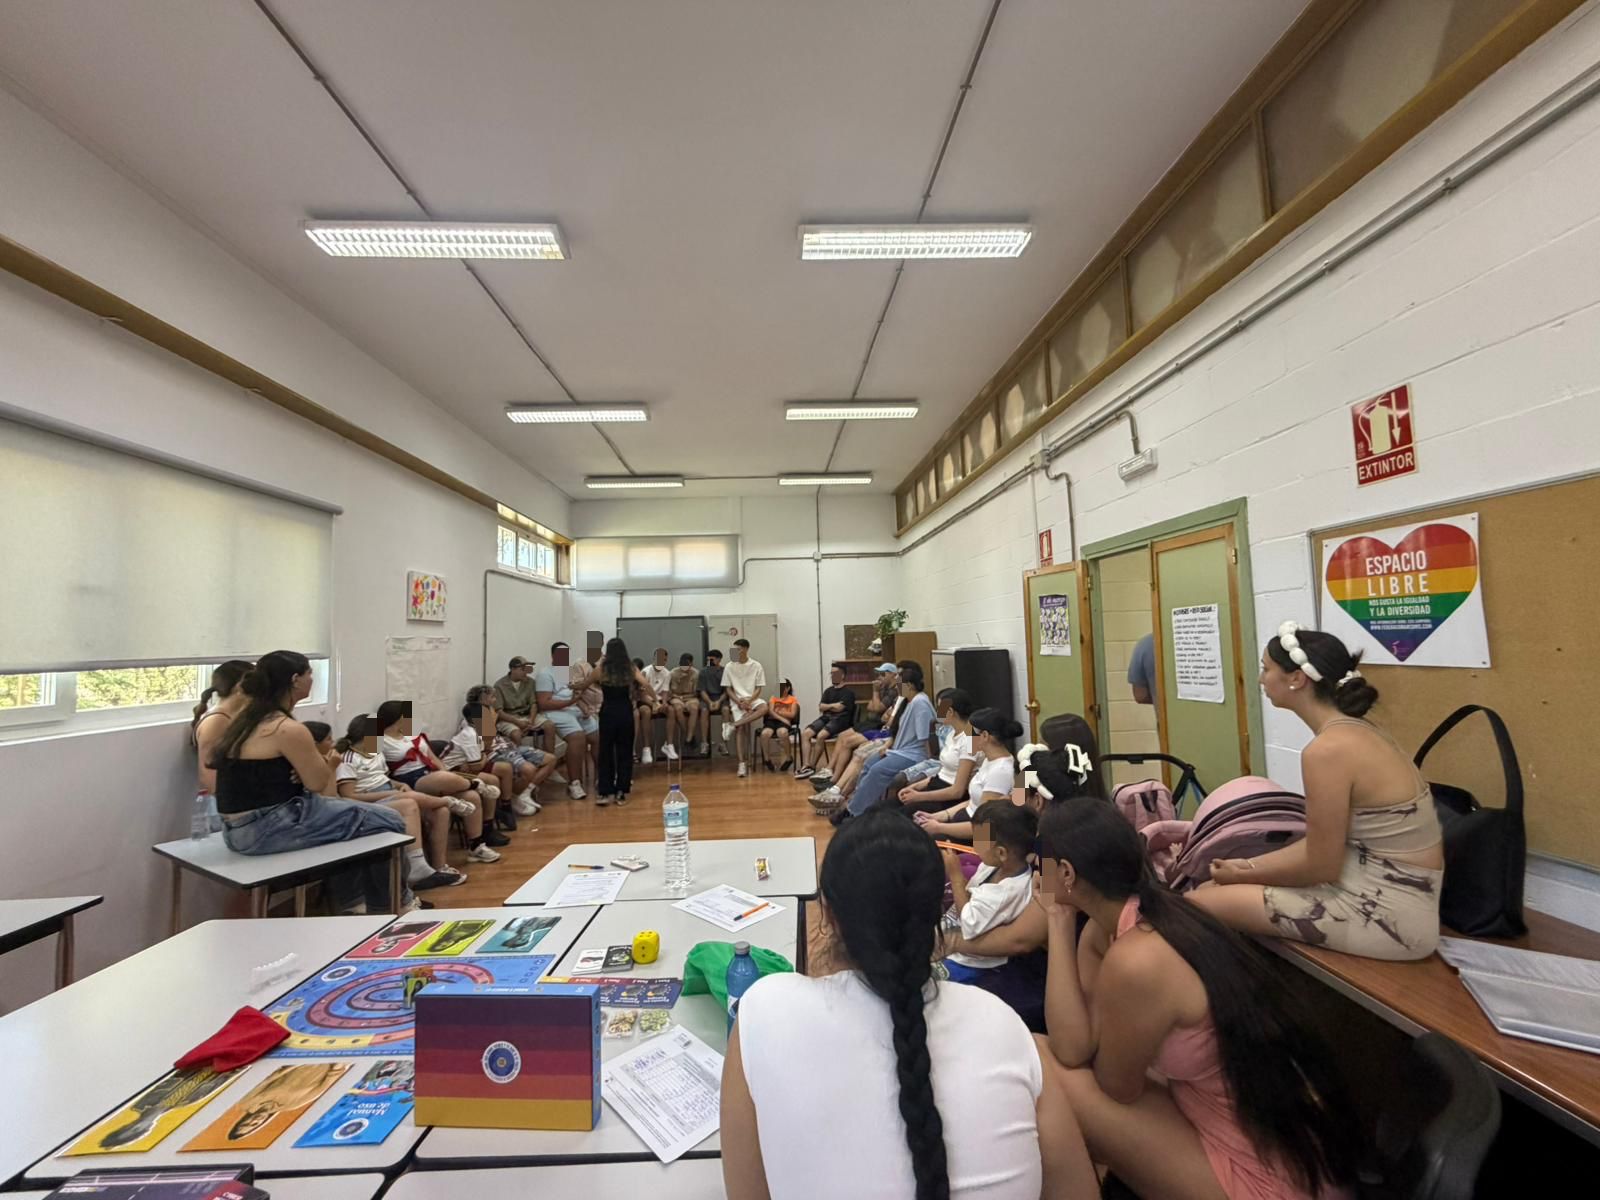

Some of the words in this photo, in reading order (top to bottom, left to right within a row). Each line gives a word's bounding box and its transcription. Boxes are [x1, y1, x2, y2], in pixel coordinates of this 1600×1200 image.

[1358, 452, 1414, 480] EXTINTOR
[1365, 550, 1427, 576] ESPACIO
[1367, 573, 1429, 597] LIBRE
[1379, 598, 1395, 606] GUSTA
[1396, 597, 1403, 605] LA
[1403, 595, 1430, 604] IGUALDAD
[1369, 607, 1375, 617] Y
[1376, 606, 1385, 616] LA
[1387, 604, 1431, 616] DIVERSIDAD
[346, 1108, 387, 1117] Manual
